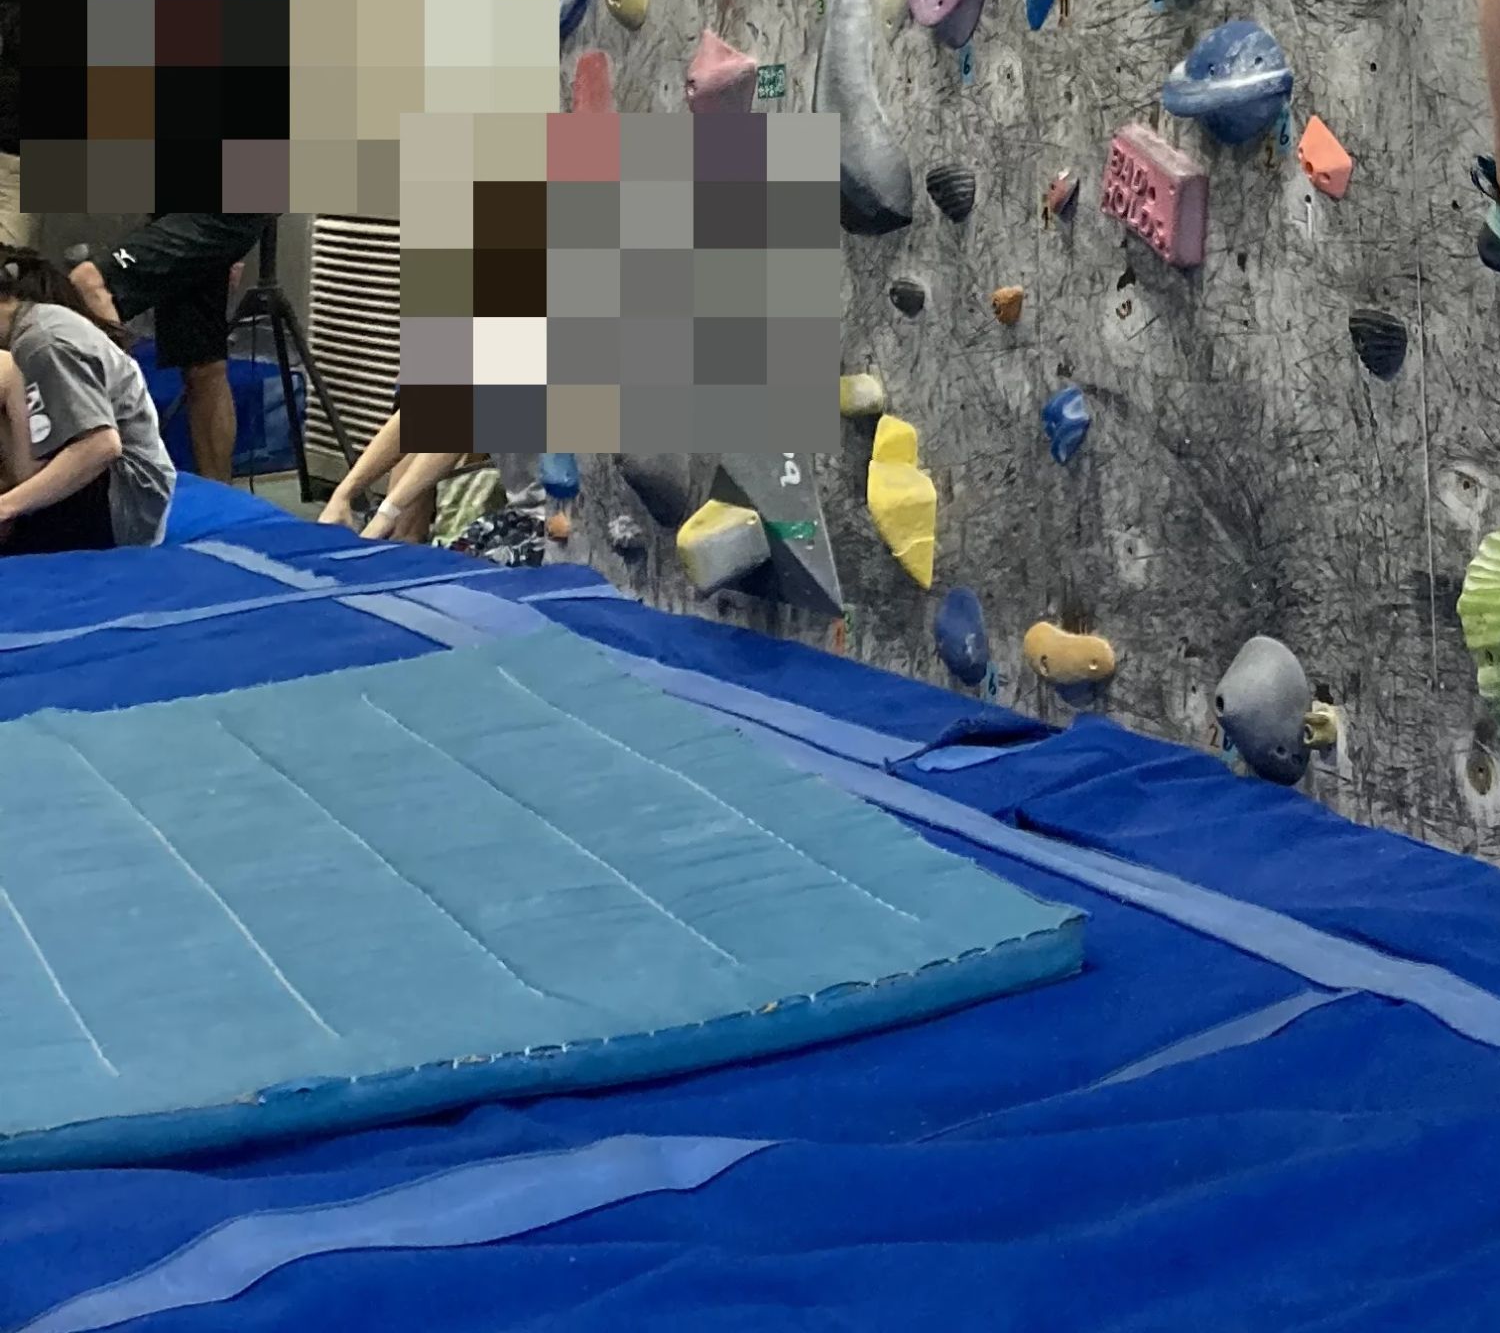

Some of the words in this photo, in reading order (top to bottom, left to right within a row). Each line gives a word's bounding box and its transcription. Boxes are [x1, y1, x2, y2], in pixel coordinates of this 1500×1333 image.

[963, 55, 971, 75] 6
[1279, 127, 1289, 146] 6
[986, 672, 997, 694] 6
